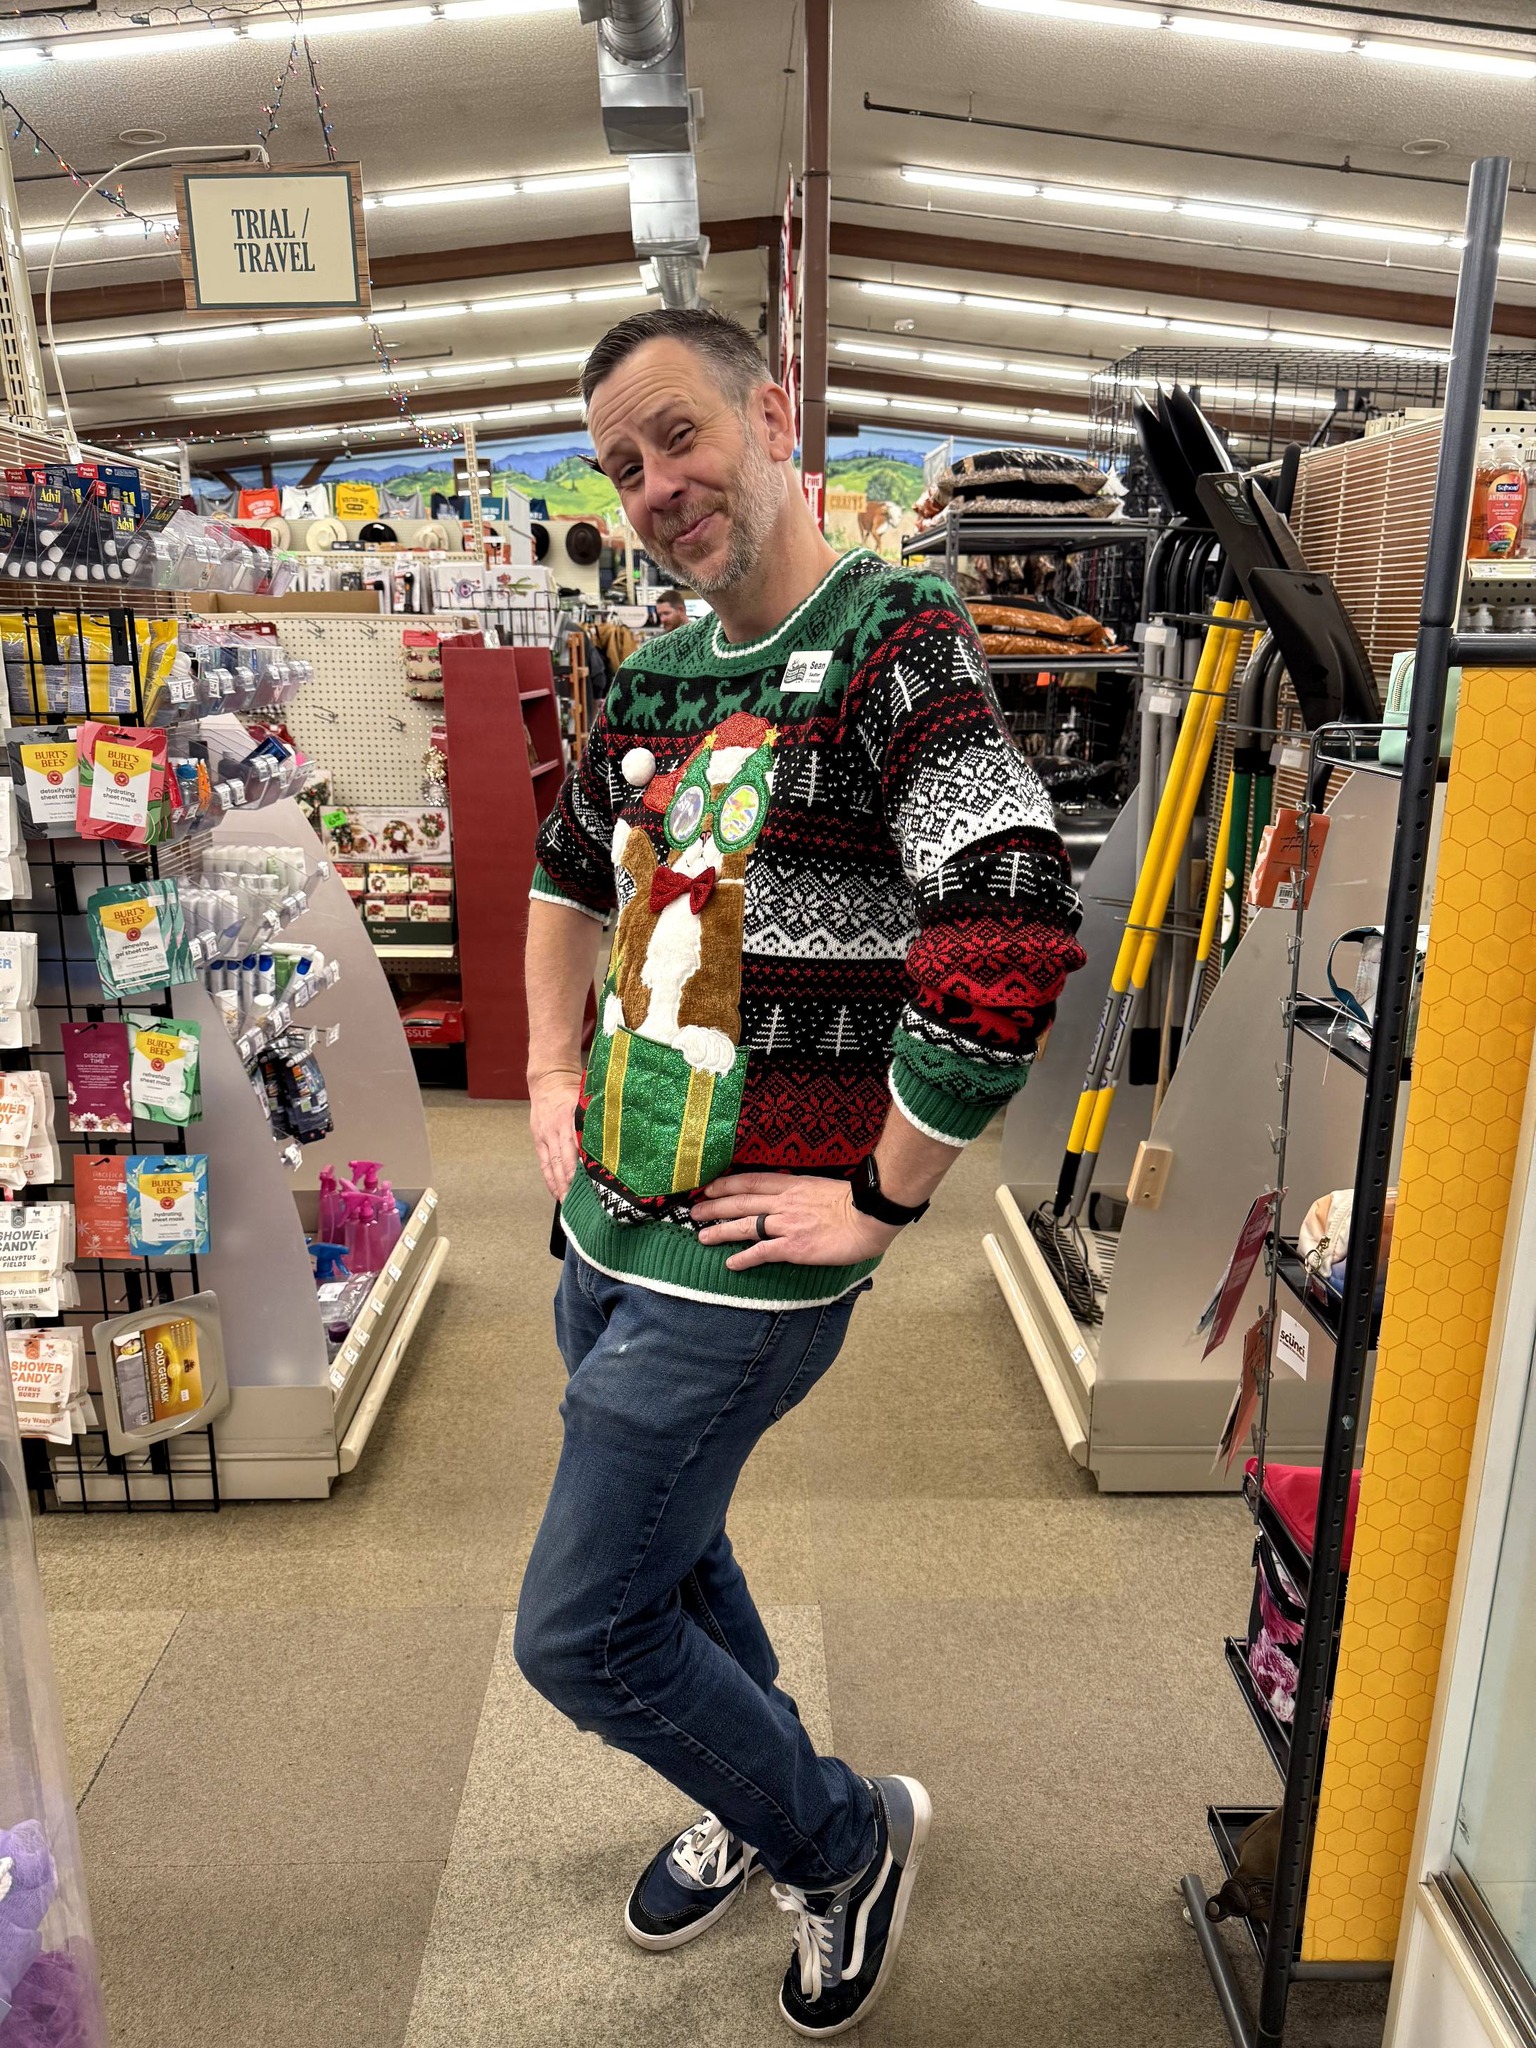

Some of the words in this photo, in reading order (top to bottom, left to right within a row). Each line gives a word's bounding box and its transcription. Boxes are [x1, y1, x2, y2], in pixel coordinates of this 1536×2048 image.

[231, 208, 296, 239] TRIAL
[301, 207, 310, 239] /
[233, 241, 316, 273] TRAVEL
[39, 487, 61, 504] Advil
[116, 517, 135, 532] Advil
[809, 660, 826, 670] Sean
[34, 750, 68, 760] BURT'S
[107, 750, 140, 763] BURT'S
[41, 759, 65, 768] BEES
[111, 759, 135, 770] BEES
[40, 787, 75, 795] detoxifying
[105, 786, 136, 798] hydrating
[102, 793, 119, 801] sheet
[120, 796, 137, 804] mask
[113, 907, 145, 920] BURT'S
[119, 915, 142, 926] BEES
[121, 940, 150, 950] renewing
[124, 949, 142, 957] sheet
[142, 945, 159, 953] mask
[406, 1028, 432, 1038] SSUE
[146, 1038, 175, 1050] BURT'S
[149, 1046, 171, 1057] BEES
[142, 1072, 171, 1082] refreshing
[155, 1079, 172, 1087] mask
[29, 1152, 43, 1160] Bar
[151, 1179, 182, 1188] BURT'S
[156, 1186, 179, 1195] BEES
[153, 1211, 182, 1219] hydrating
[38, 1286, 51, 1294] Bar
[1280, 1330, 1305, 1358] scünci
[154, 1342, 165, 1366] GOLD
[11, 1361, 63, 1374] SHOWER
[158, 1367, 167, 1382] GEL
[17, 1385, 42, 1393] CITRUS
[160, 1382, 169, 1404] MASK
[18, 1391, 41, 1399] BURST
[32, 1416, 51, 1424] Wash
